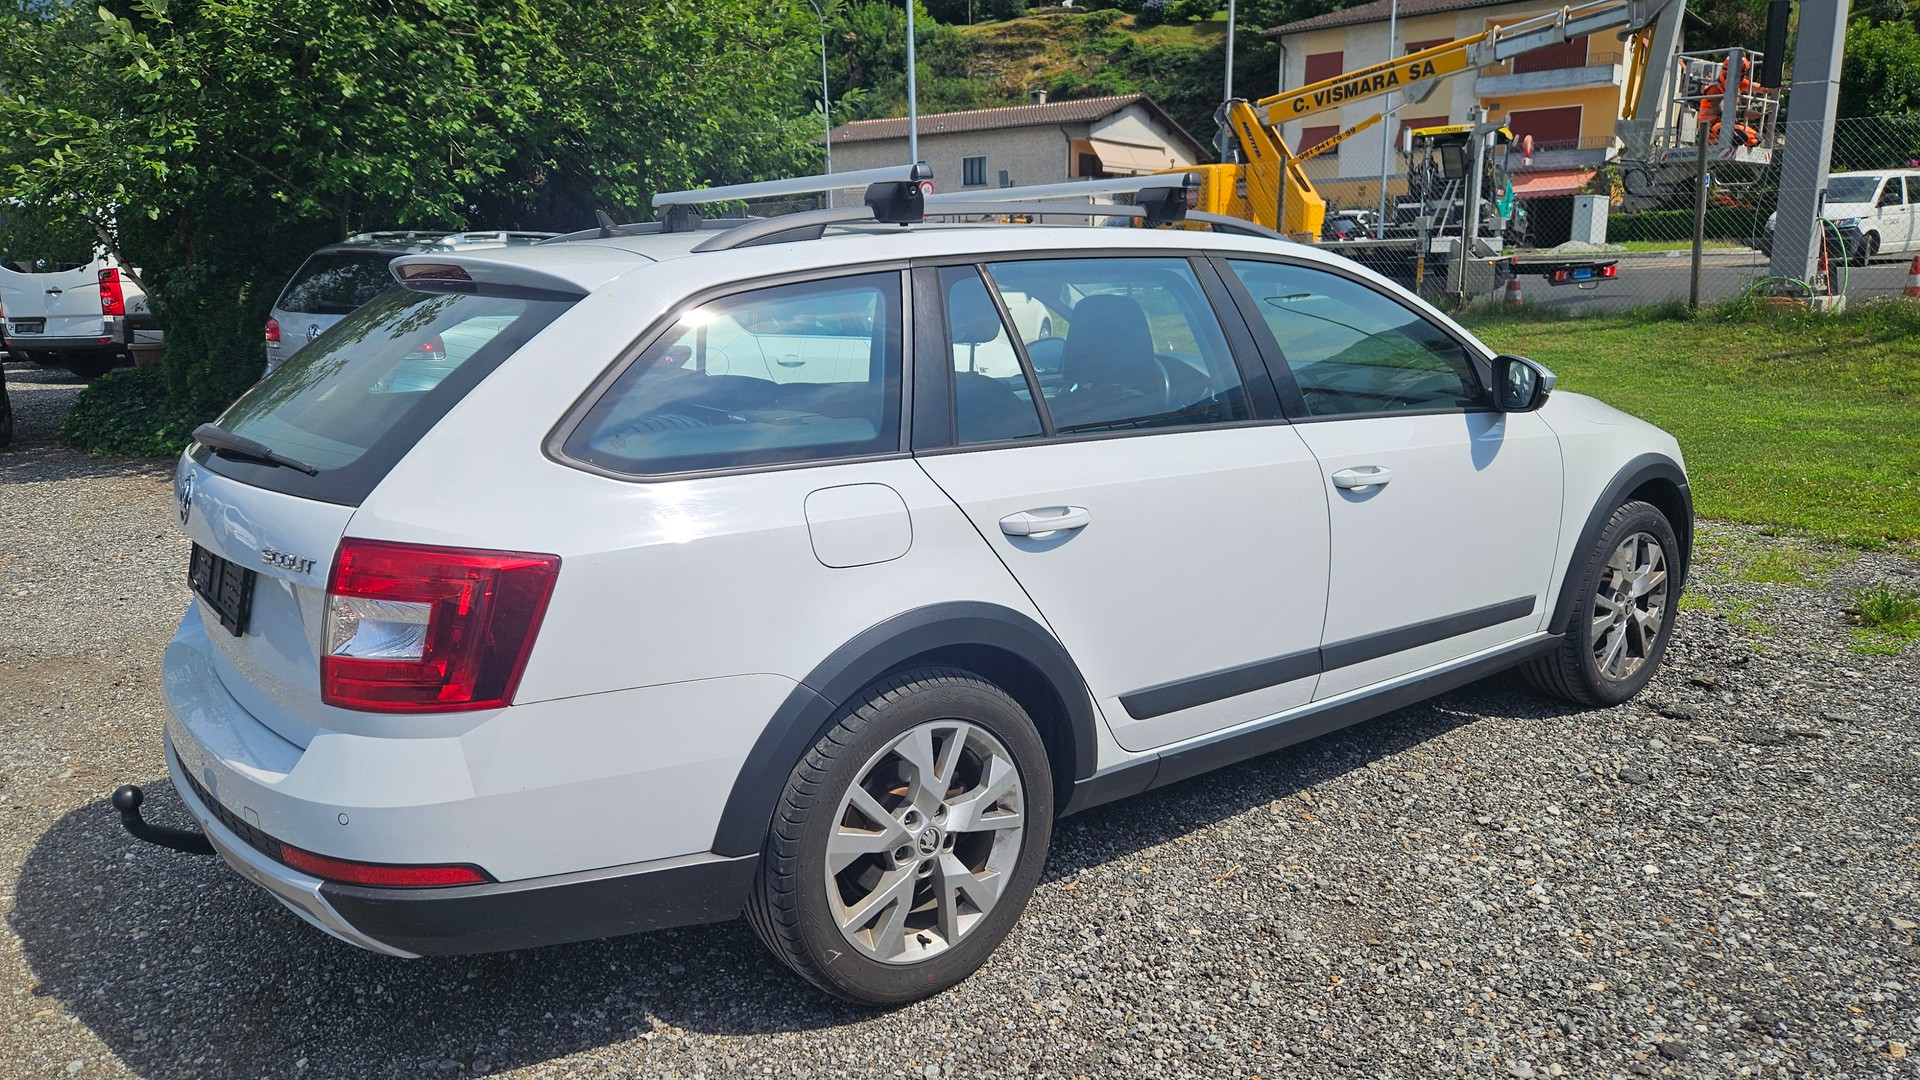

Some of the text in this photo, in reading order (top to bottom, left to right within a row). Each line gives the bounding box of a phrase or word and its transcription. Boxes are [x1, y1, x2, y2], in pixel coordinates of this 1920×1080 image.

[1292, 60, 1436, 113] C. VISMARA SA
[1330, 61, 1395, 85] www.vismara.ch
[261, 547, 317, 575] SCOUT
